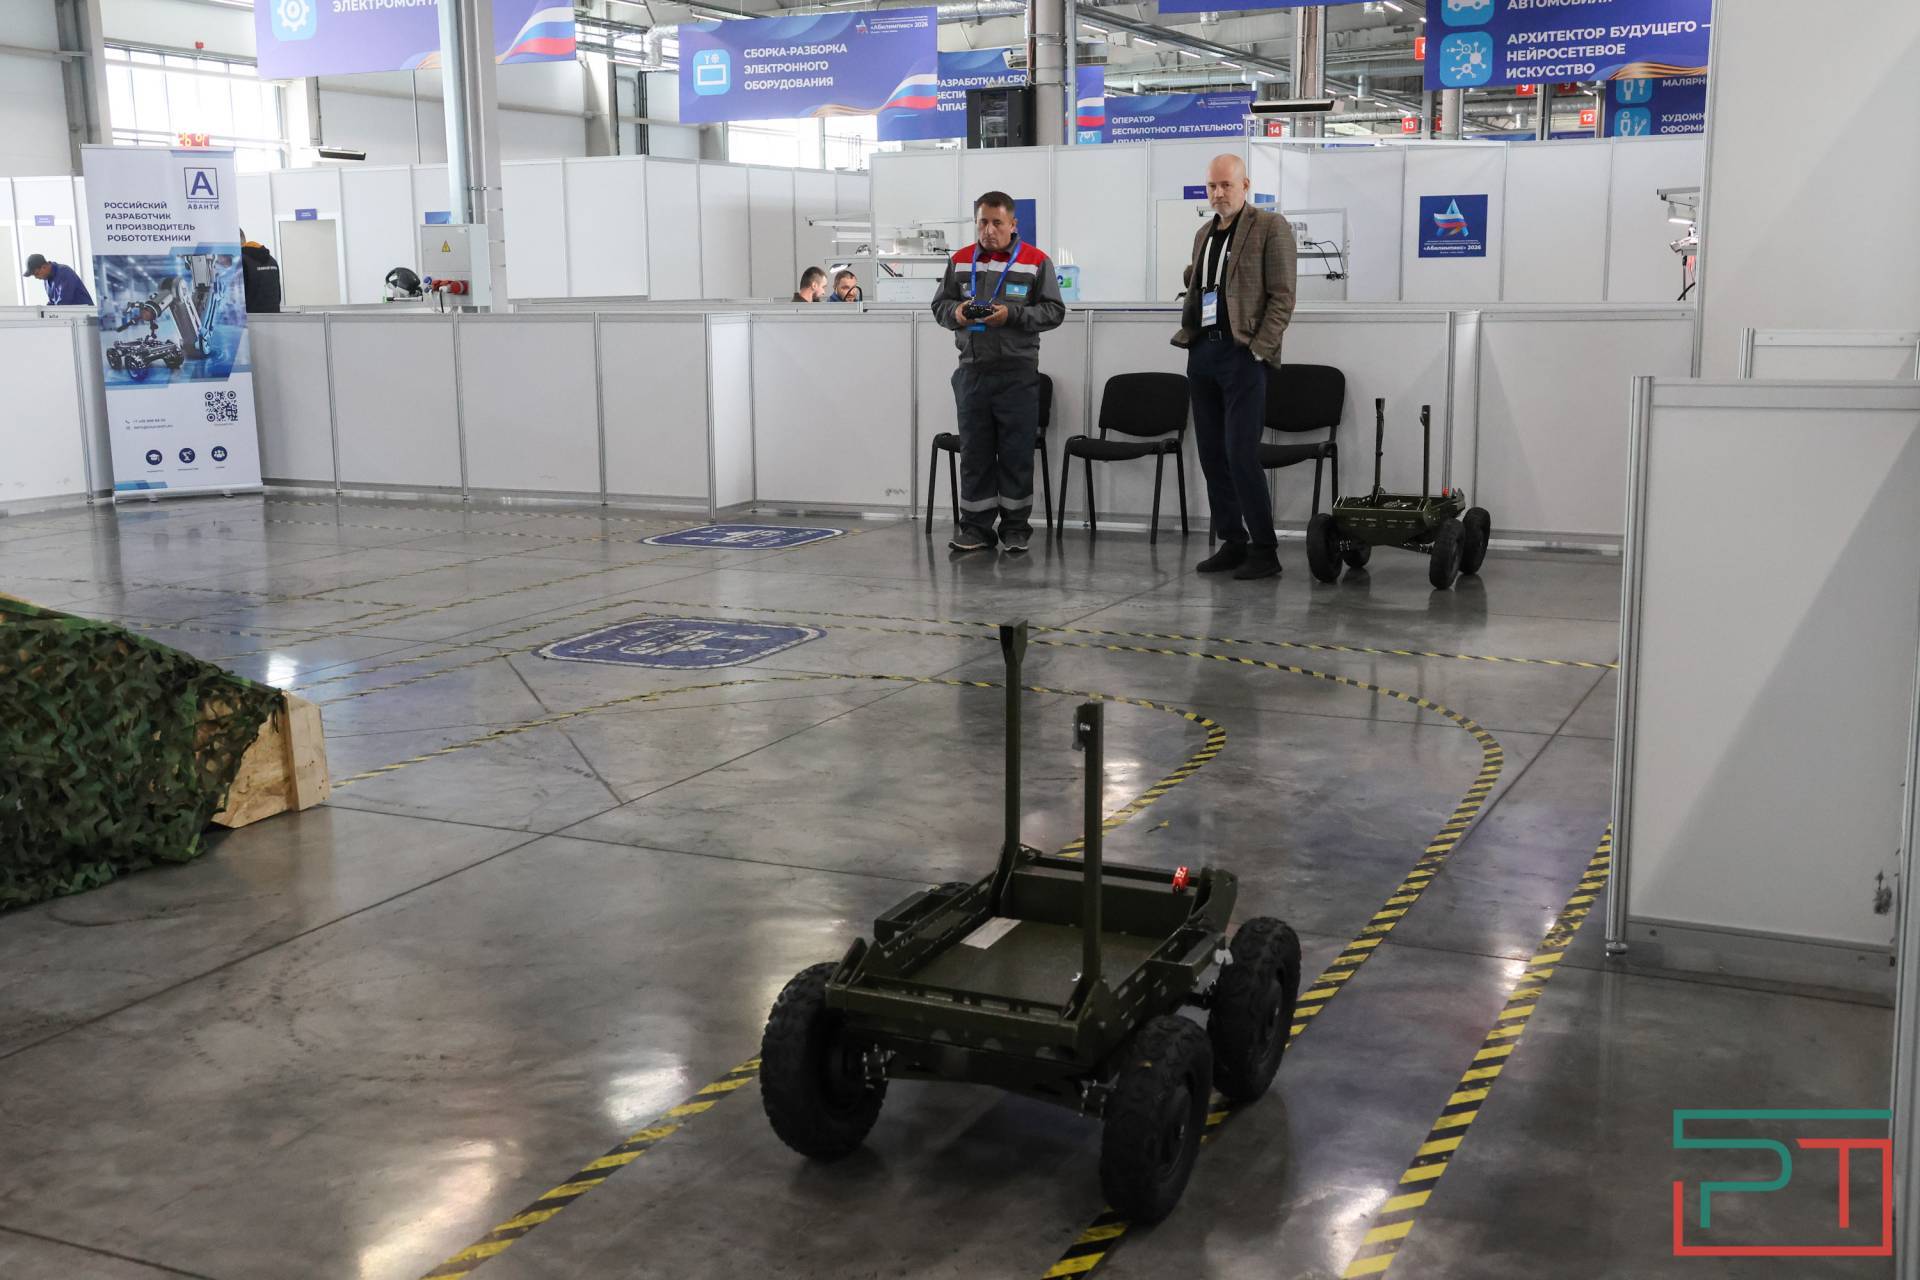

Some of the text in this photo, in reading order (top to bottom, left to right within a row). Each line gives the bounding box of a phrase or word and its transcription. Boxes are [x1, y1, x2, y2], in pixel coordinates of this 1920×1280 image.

[333, 0, 438, 13] ЭЛЕКТРОМОН
[1507, 0, 1612, 10] АВТОМО
[1507, 27, 1605, 45] АРХИТЕКТОР
[1610, 21, 1697, 39] БУДУЩЕГО
[743, 43, 848, 58] СБОРКА-РАЗБОРКА
[1506, 44, 1626, 62] НЕЙРОСЕТЕВОЕ
[744, 60, 829, 74] ЭЛЕКТРОННОГО
[1506, 63, 1595, 79] ИСКУССТВО
[744, 77, 834, 90] ОБОРУДОВАНИЯ
[998, 76, 1006, 84] И
[1112, 115, 1155, 124] ОПЕРАТОР
[1583, 113, 1593, 122] 12
[1112, 123, 1244, 135] БЕСПИЛОТНОГО ЛЕТАТЕЛЬНОГО
[1270, 126, 1280, 134] 14
[1404, 121, 1414, 129] 13
[104, 200, 168, 209] РОССИЙСКИЙ
[106, 223, 196, 231] И ПРОИЗВОДИТЕЛЬ
[107, 234, 191, 242] РОБОТОТЕХНИКИ
